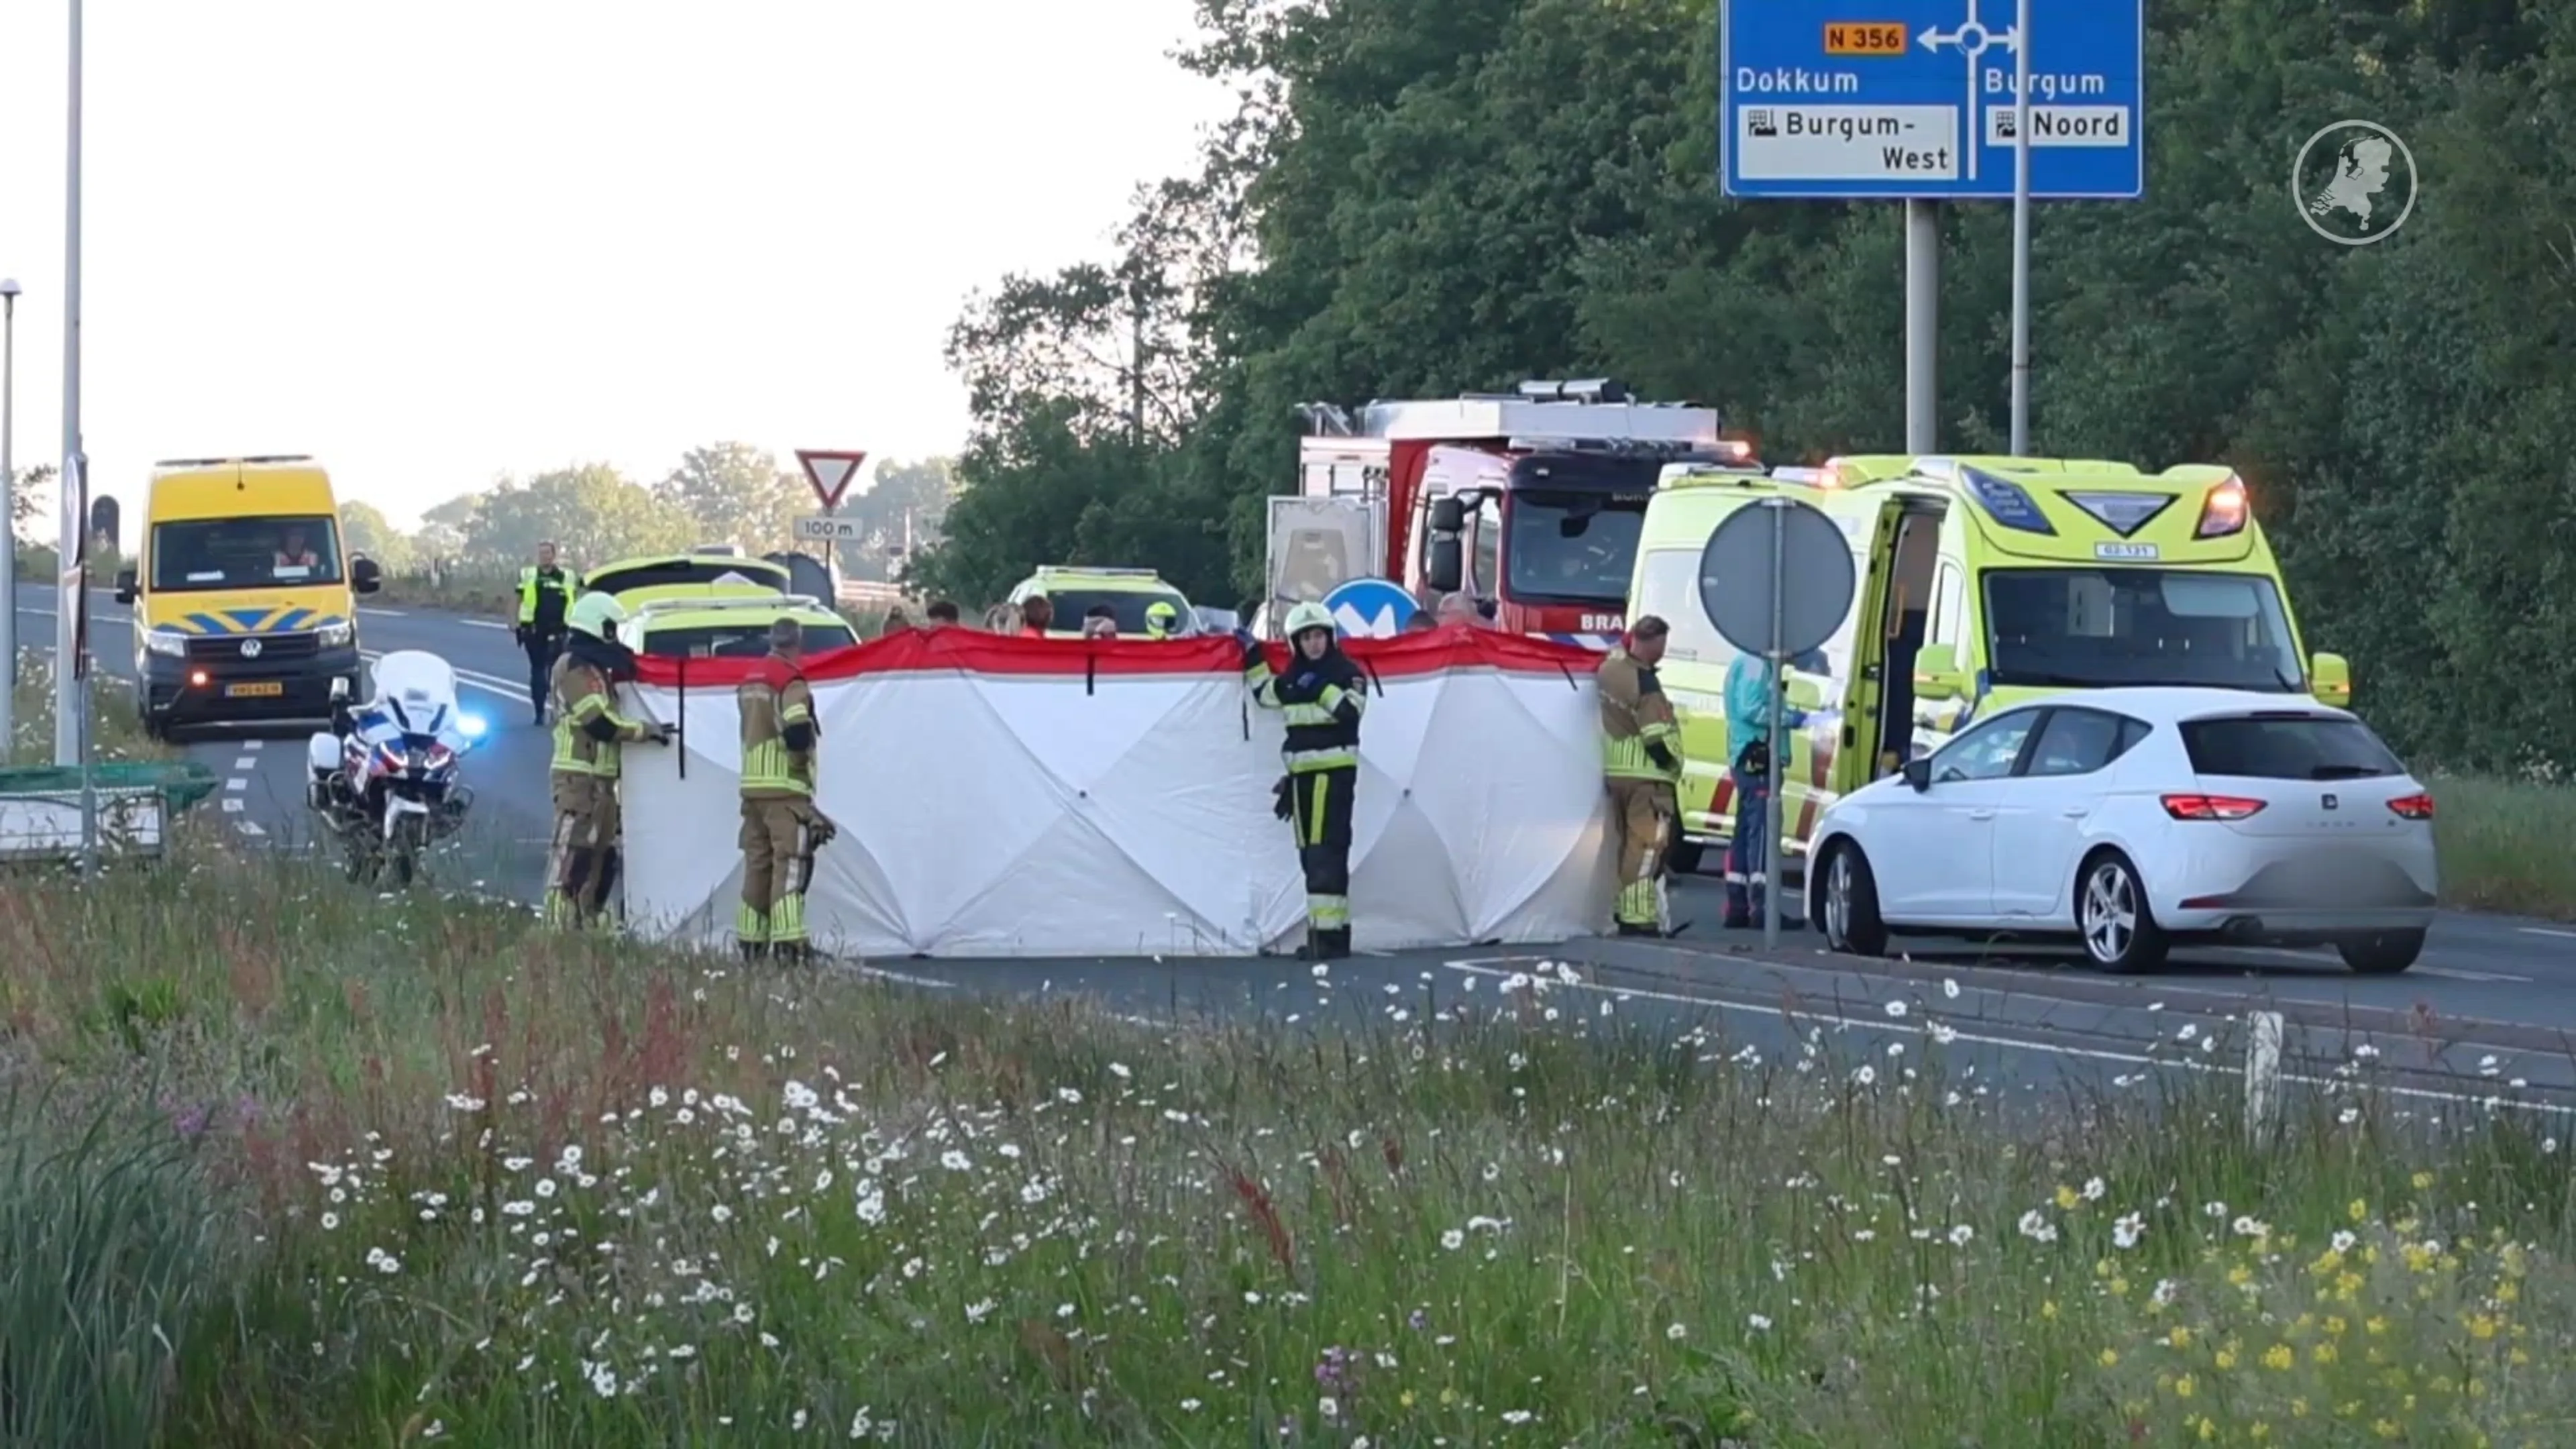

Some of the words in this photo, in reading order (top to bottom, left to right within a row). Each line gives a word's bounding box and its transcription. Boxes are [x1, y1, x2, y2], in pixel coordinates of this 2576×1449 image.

[1829, 28, 1844, 49] N
[1853, 28, 1900, 49] 356
[1737, 67, 1858, 93] Dokkum
[1986, 68, 2104, 101] Burgum
[1786, 112, 1916, 142] Burgum-
[2035, 111, 2118, 136] Noord
[1883, 146, 1949, 170] West
[806, 521, 834, 535] 100
[838, 525, 853, 536] m
